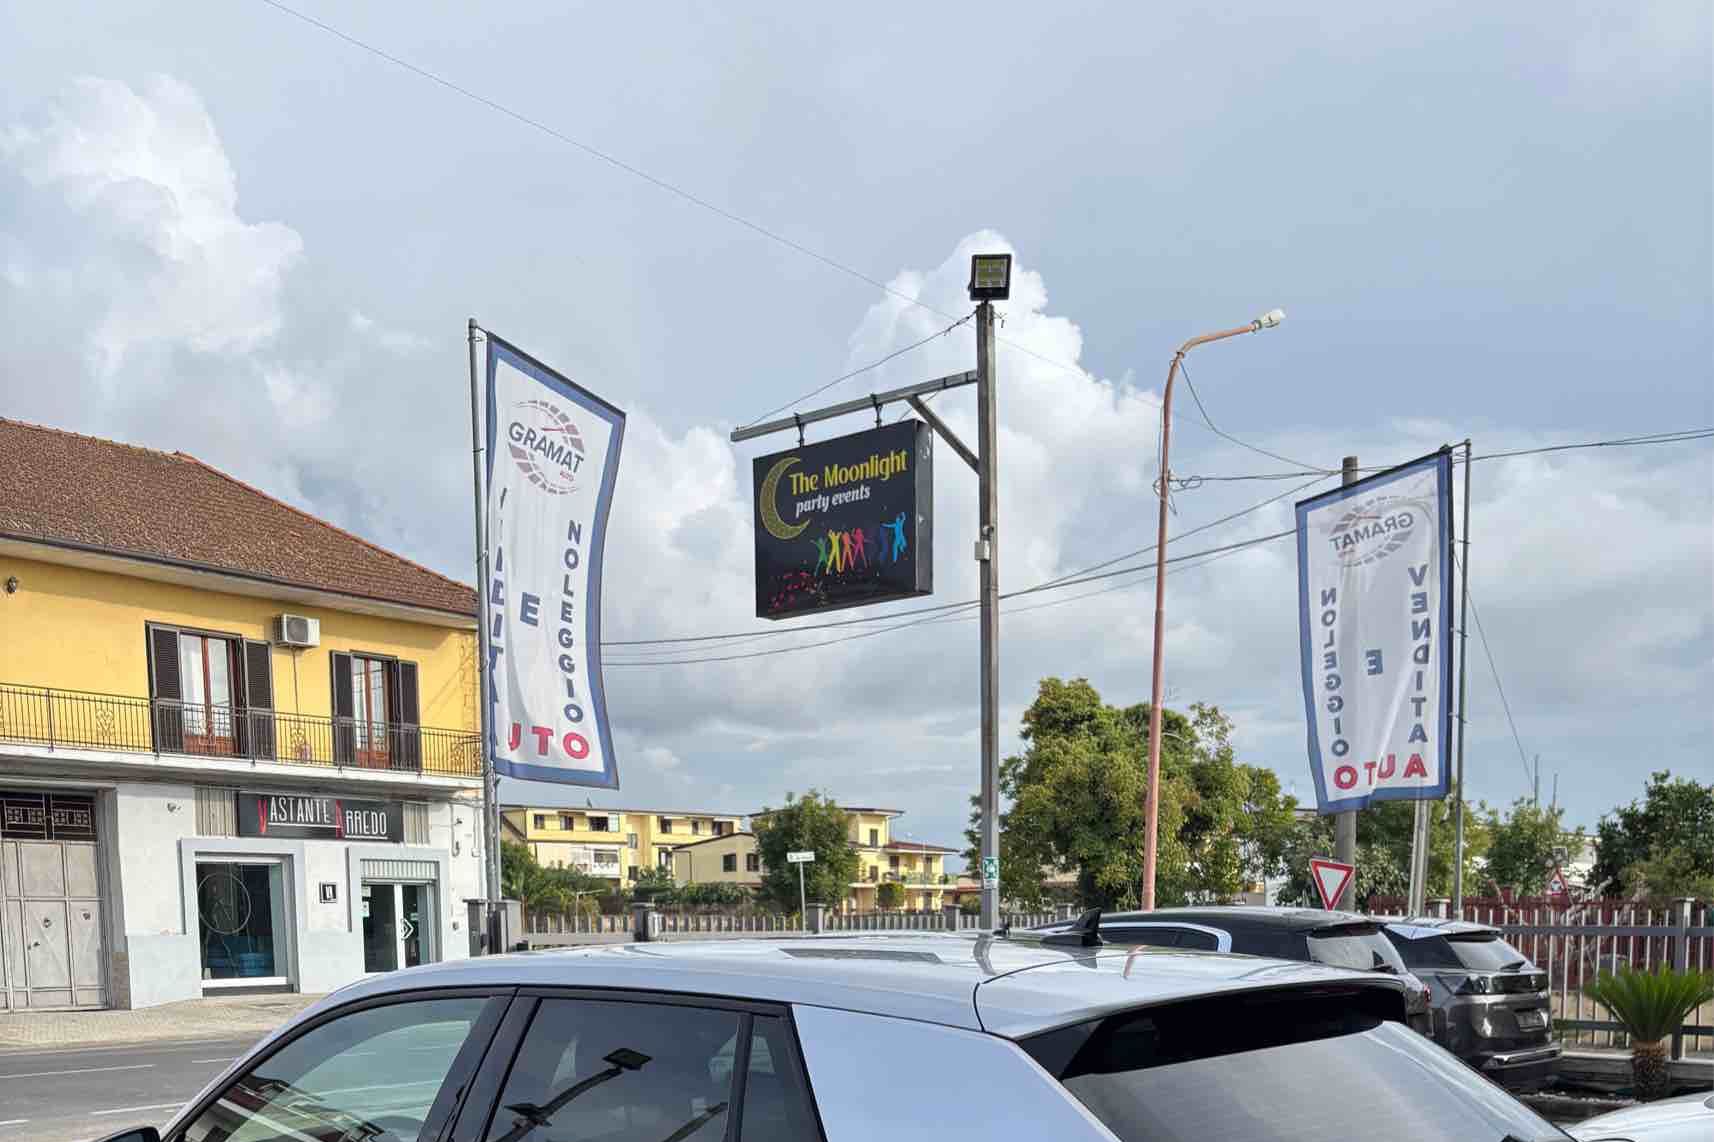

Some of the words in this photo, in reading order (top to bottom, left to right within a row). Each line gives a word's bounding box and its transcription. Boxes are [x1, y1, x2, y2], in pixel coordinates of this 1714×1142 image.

[508, 421, 584, 473] GRAMAT
[788, 471, 819, 495] The
[824, 450, 907, 488] Moonlight
[795, 494, 830, 518] party
[831, 484, 871, 506] events
[520, 591, 541, 627] E
[558, 519, 584, 723] NOLEGGIO
[497, 722, 590, 760] UTO
